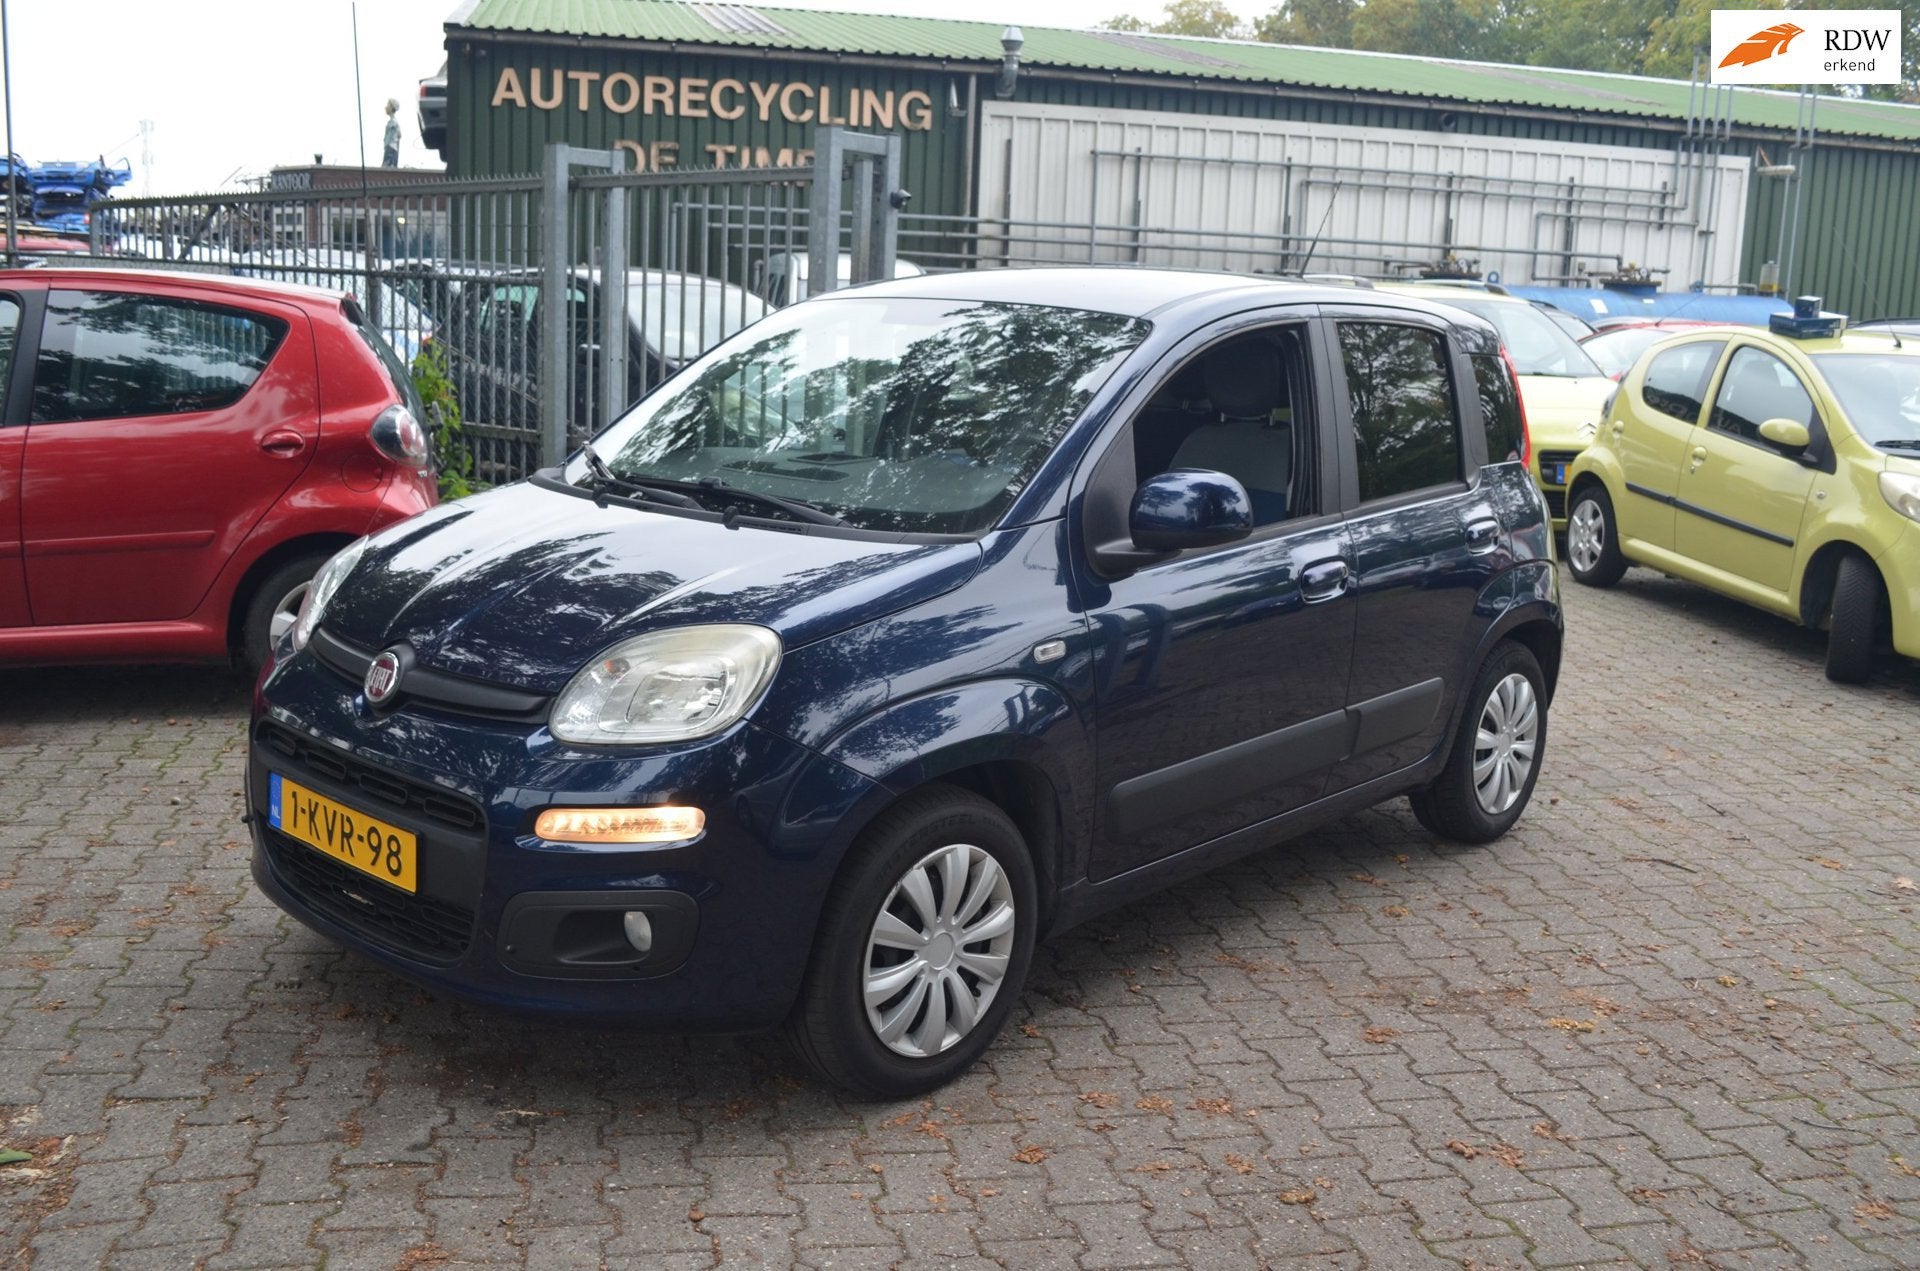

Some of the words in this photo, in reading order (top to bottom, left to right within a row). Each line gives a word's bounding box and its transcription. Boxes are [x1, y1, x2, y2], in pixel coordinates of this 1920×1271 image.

[491, 67, 933, 131] AUTORECYCLING
[370, 665, 393, 692] FIAT
[271, 803, 281, 820] NL
[291, 790, 403, 878] 1-KVR-98
